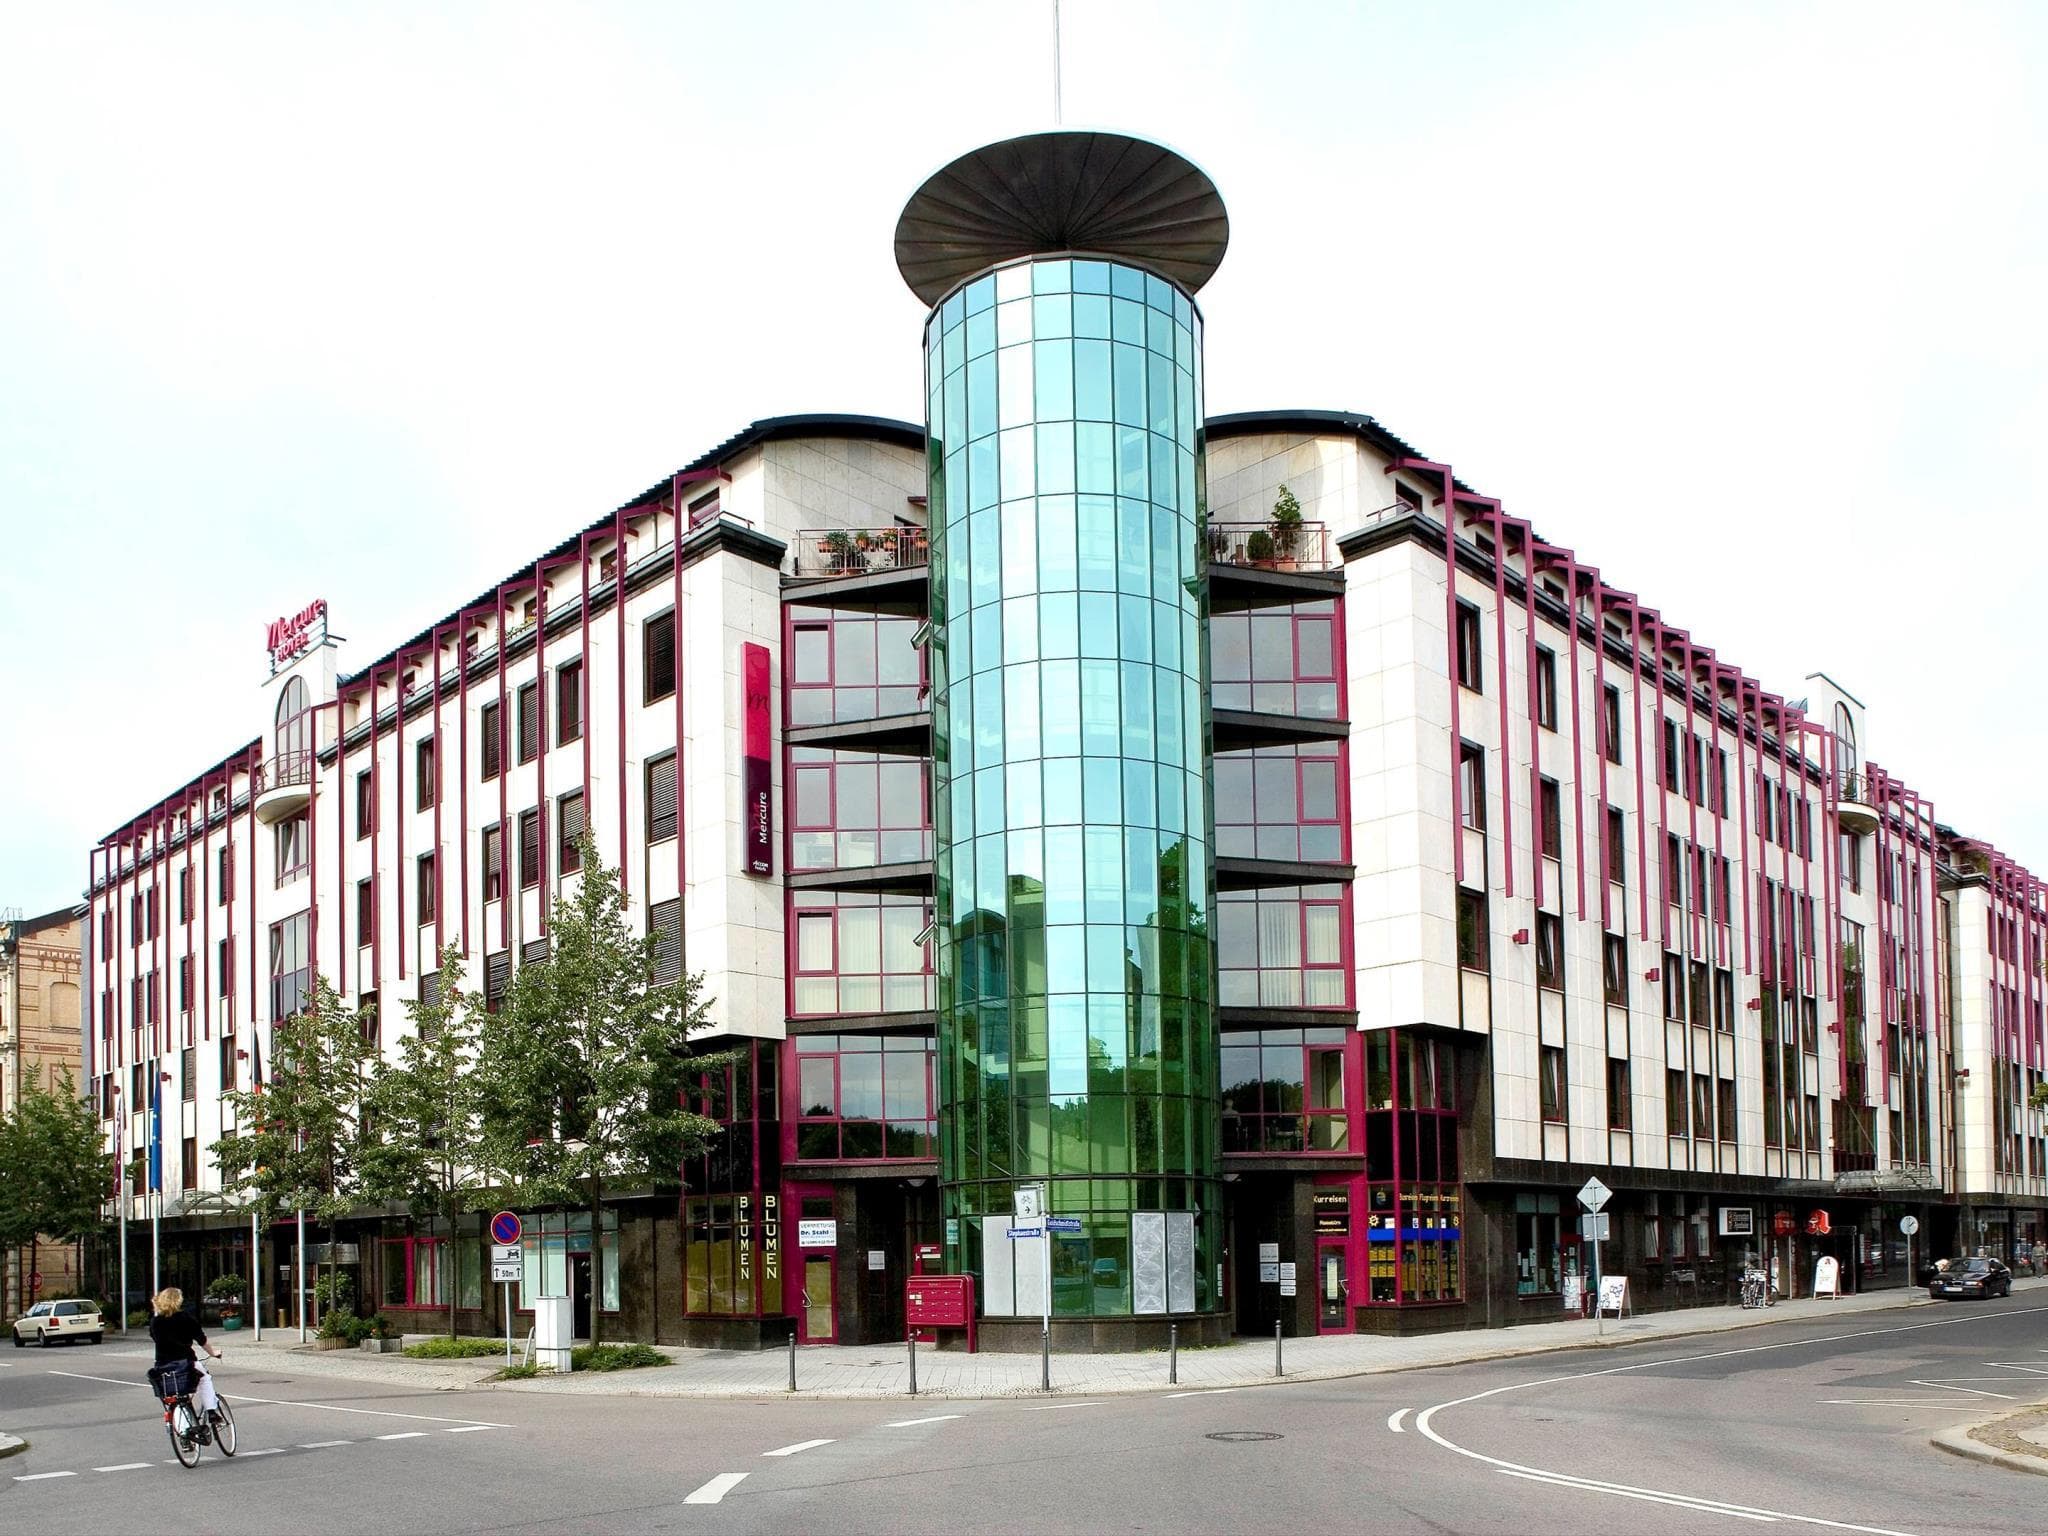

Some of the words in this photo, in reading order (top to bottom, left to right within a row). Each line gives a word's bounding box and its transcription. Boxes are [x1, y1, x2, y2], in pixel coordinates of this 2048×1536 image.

[264, 598, 327, 651] Mercure
[759, 791, 767, 844] Mercure
[740, 1196, 749, 1279] BLUMEN
[765, 1195, 777, 1279] BLUMEN
